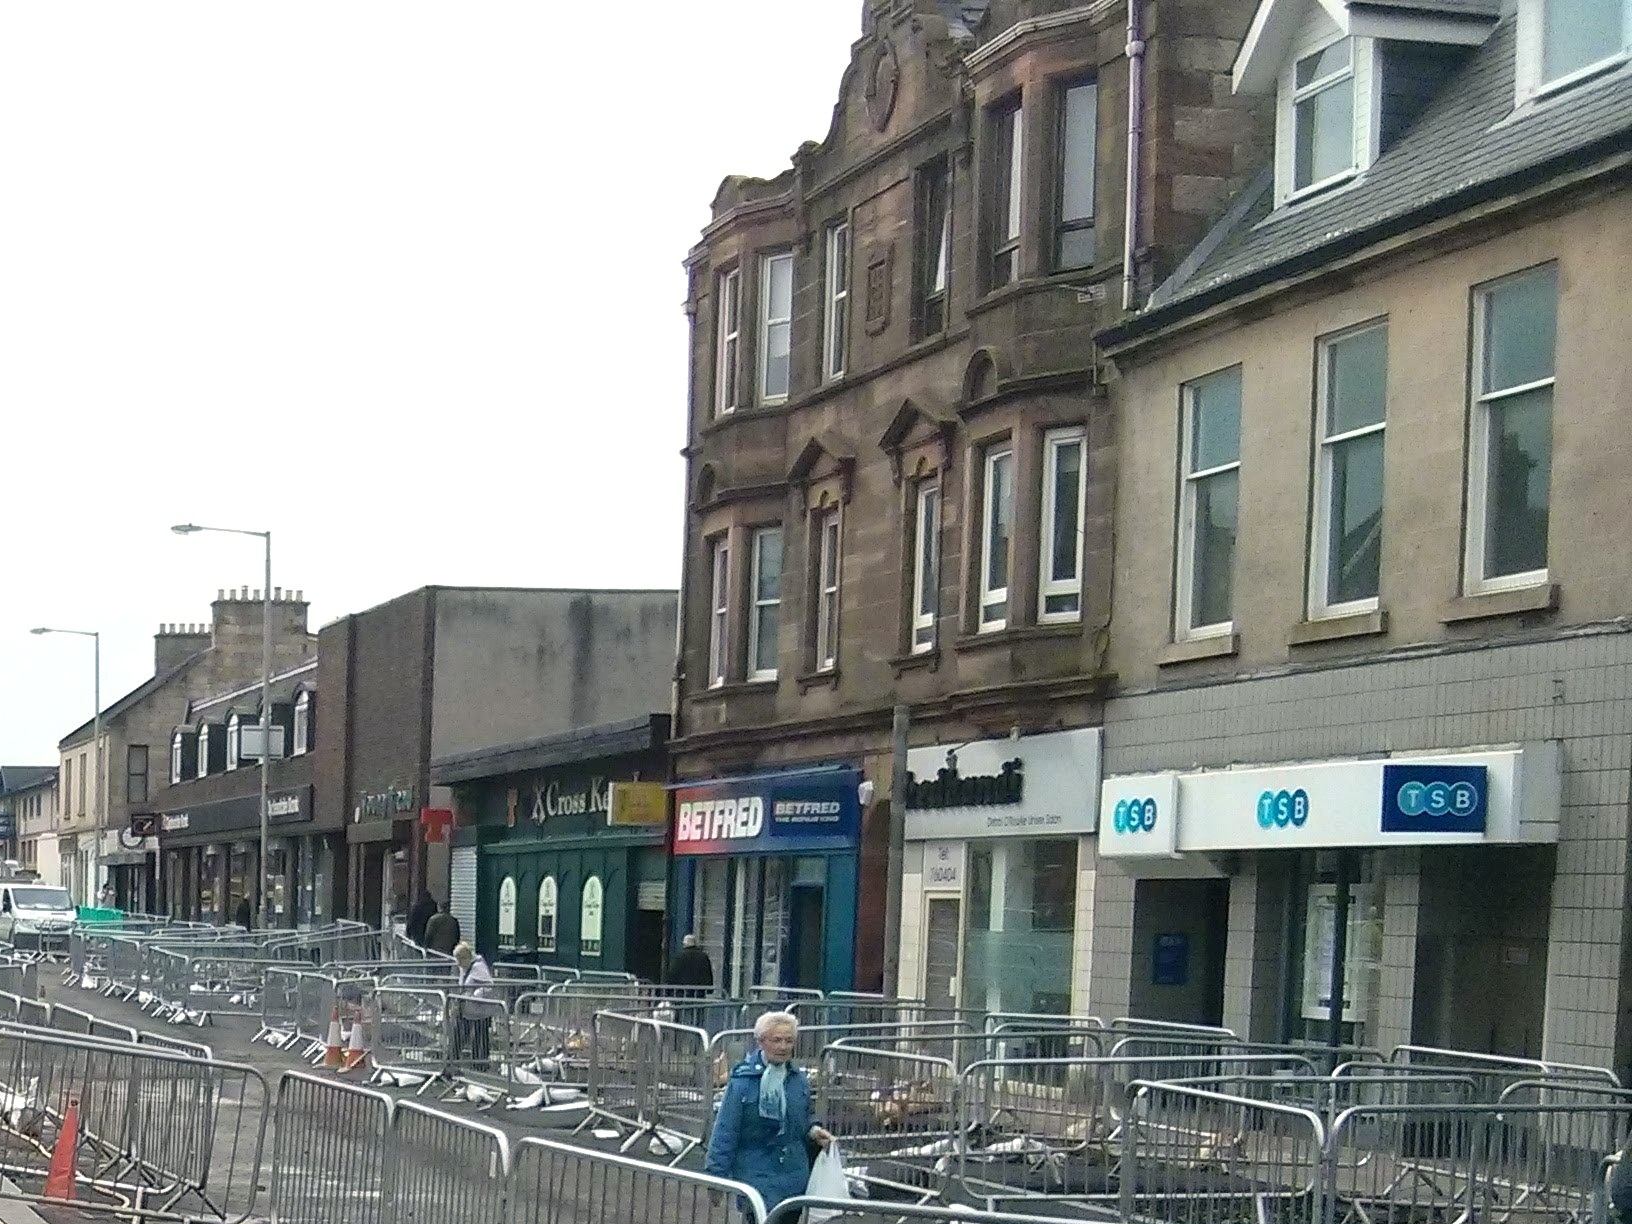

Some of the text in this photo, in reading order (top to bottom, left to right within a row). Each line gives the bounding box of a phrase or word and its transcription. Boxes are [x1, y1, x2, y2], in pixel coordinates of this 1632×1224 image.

[546, 780, 586, 817] Cross
[775, 802, 840, 815] BETFRED
[1261, 795, 1305, 822] TSB
[1404, 788, 1472, 810] TSB
[677, 796, 763, 841] BETFRED
[1117, 803, 1154, 827] TSB
